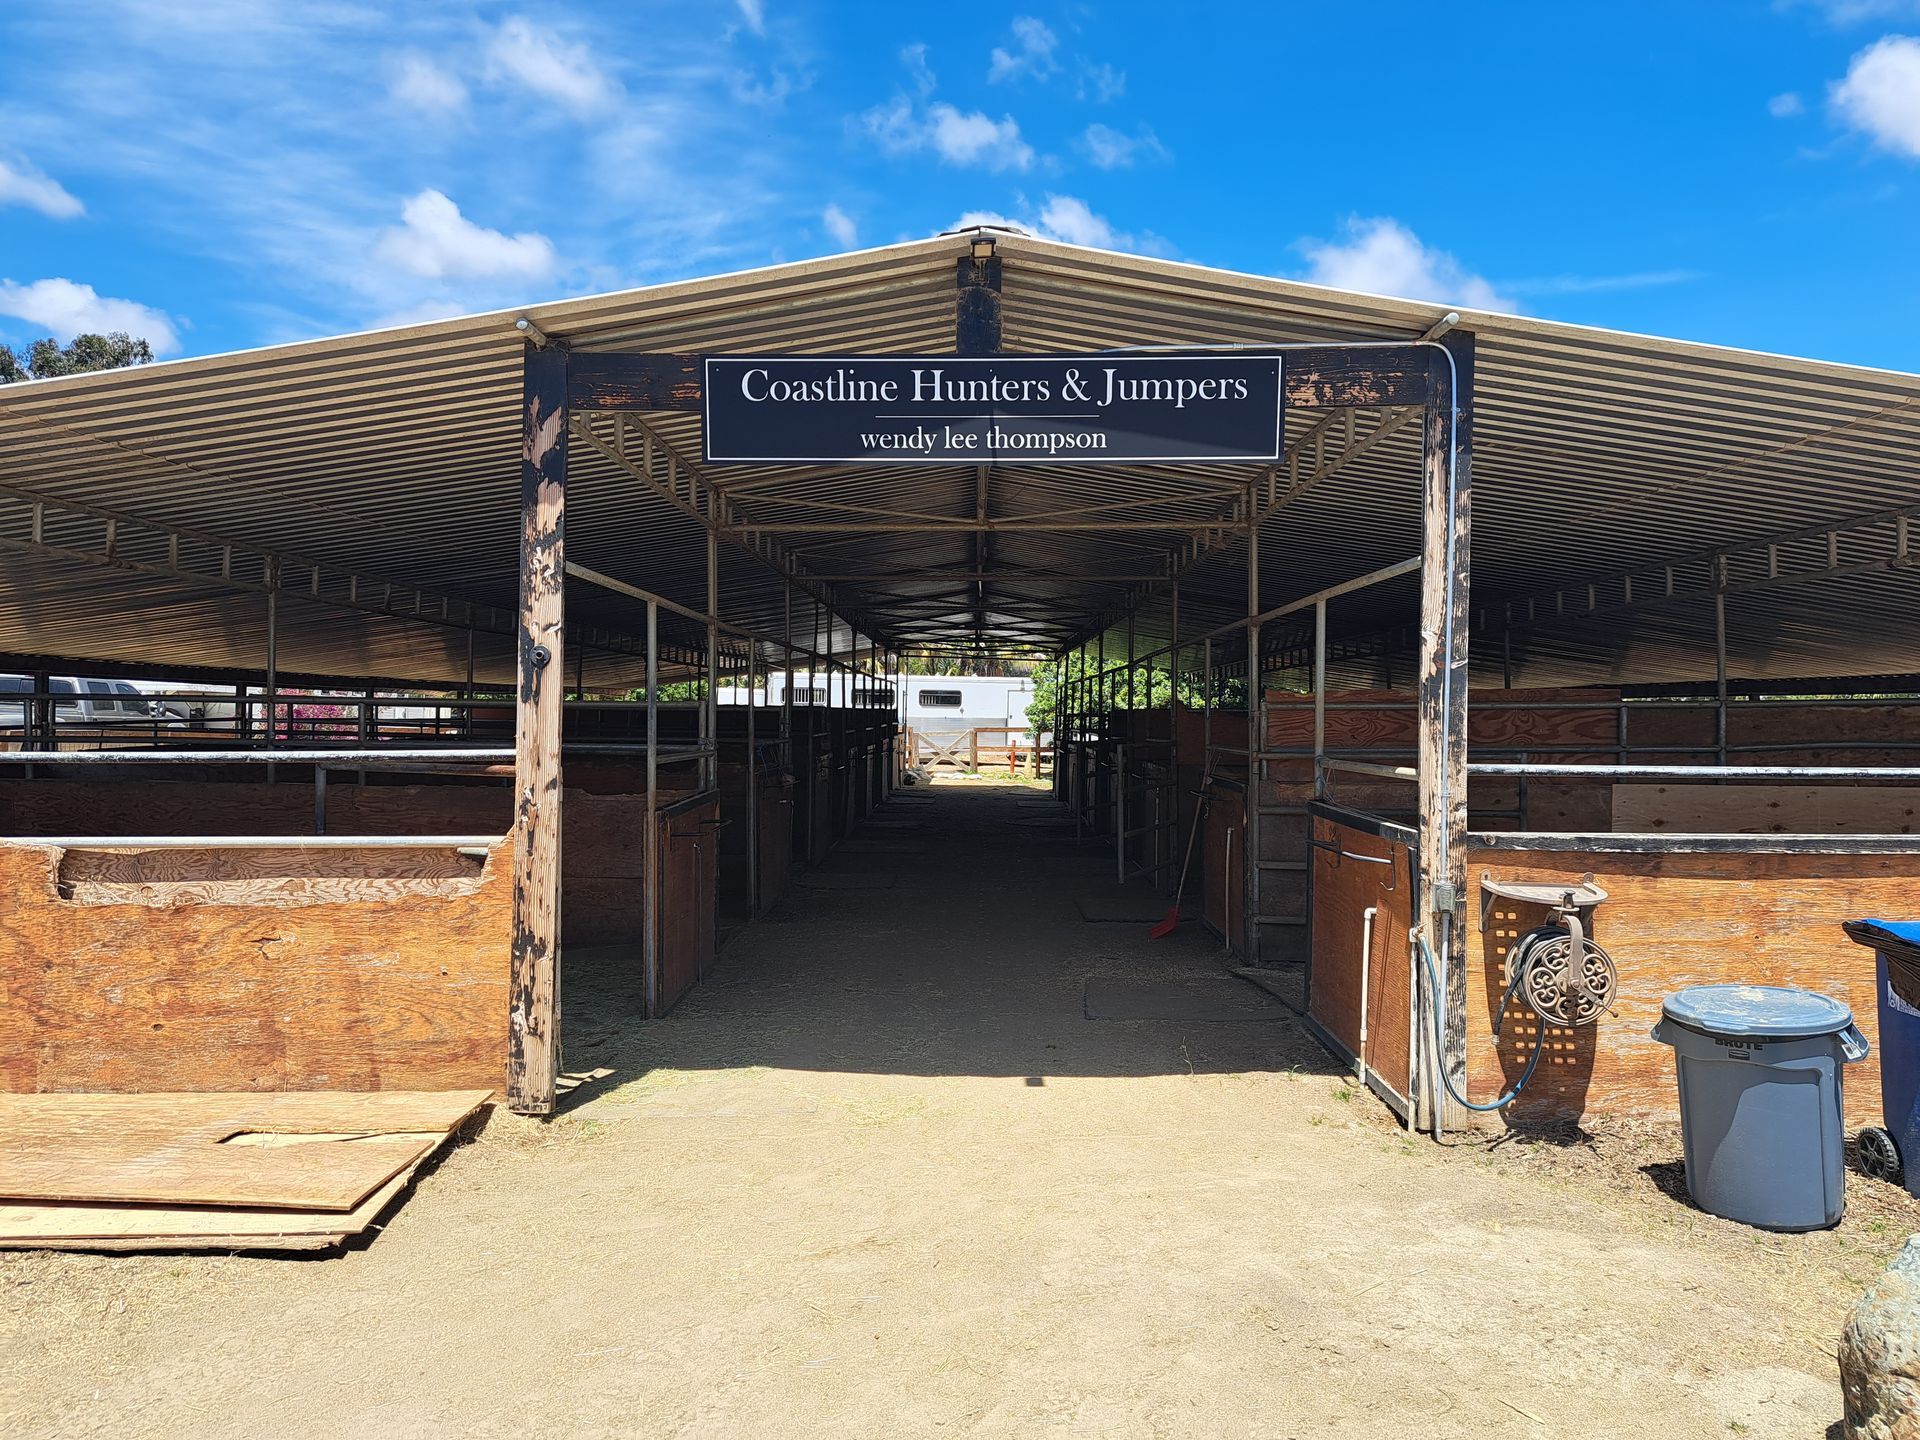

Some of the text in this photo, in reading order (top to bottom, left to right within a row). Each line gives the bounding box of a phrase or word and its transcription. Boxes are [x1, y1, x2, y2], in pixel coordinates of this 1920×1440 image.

[741, 367, 1248, 409] Coastline Hunters & Jumpers
[860, 425, 1108, 454] wendy lee thompson
